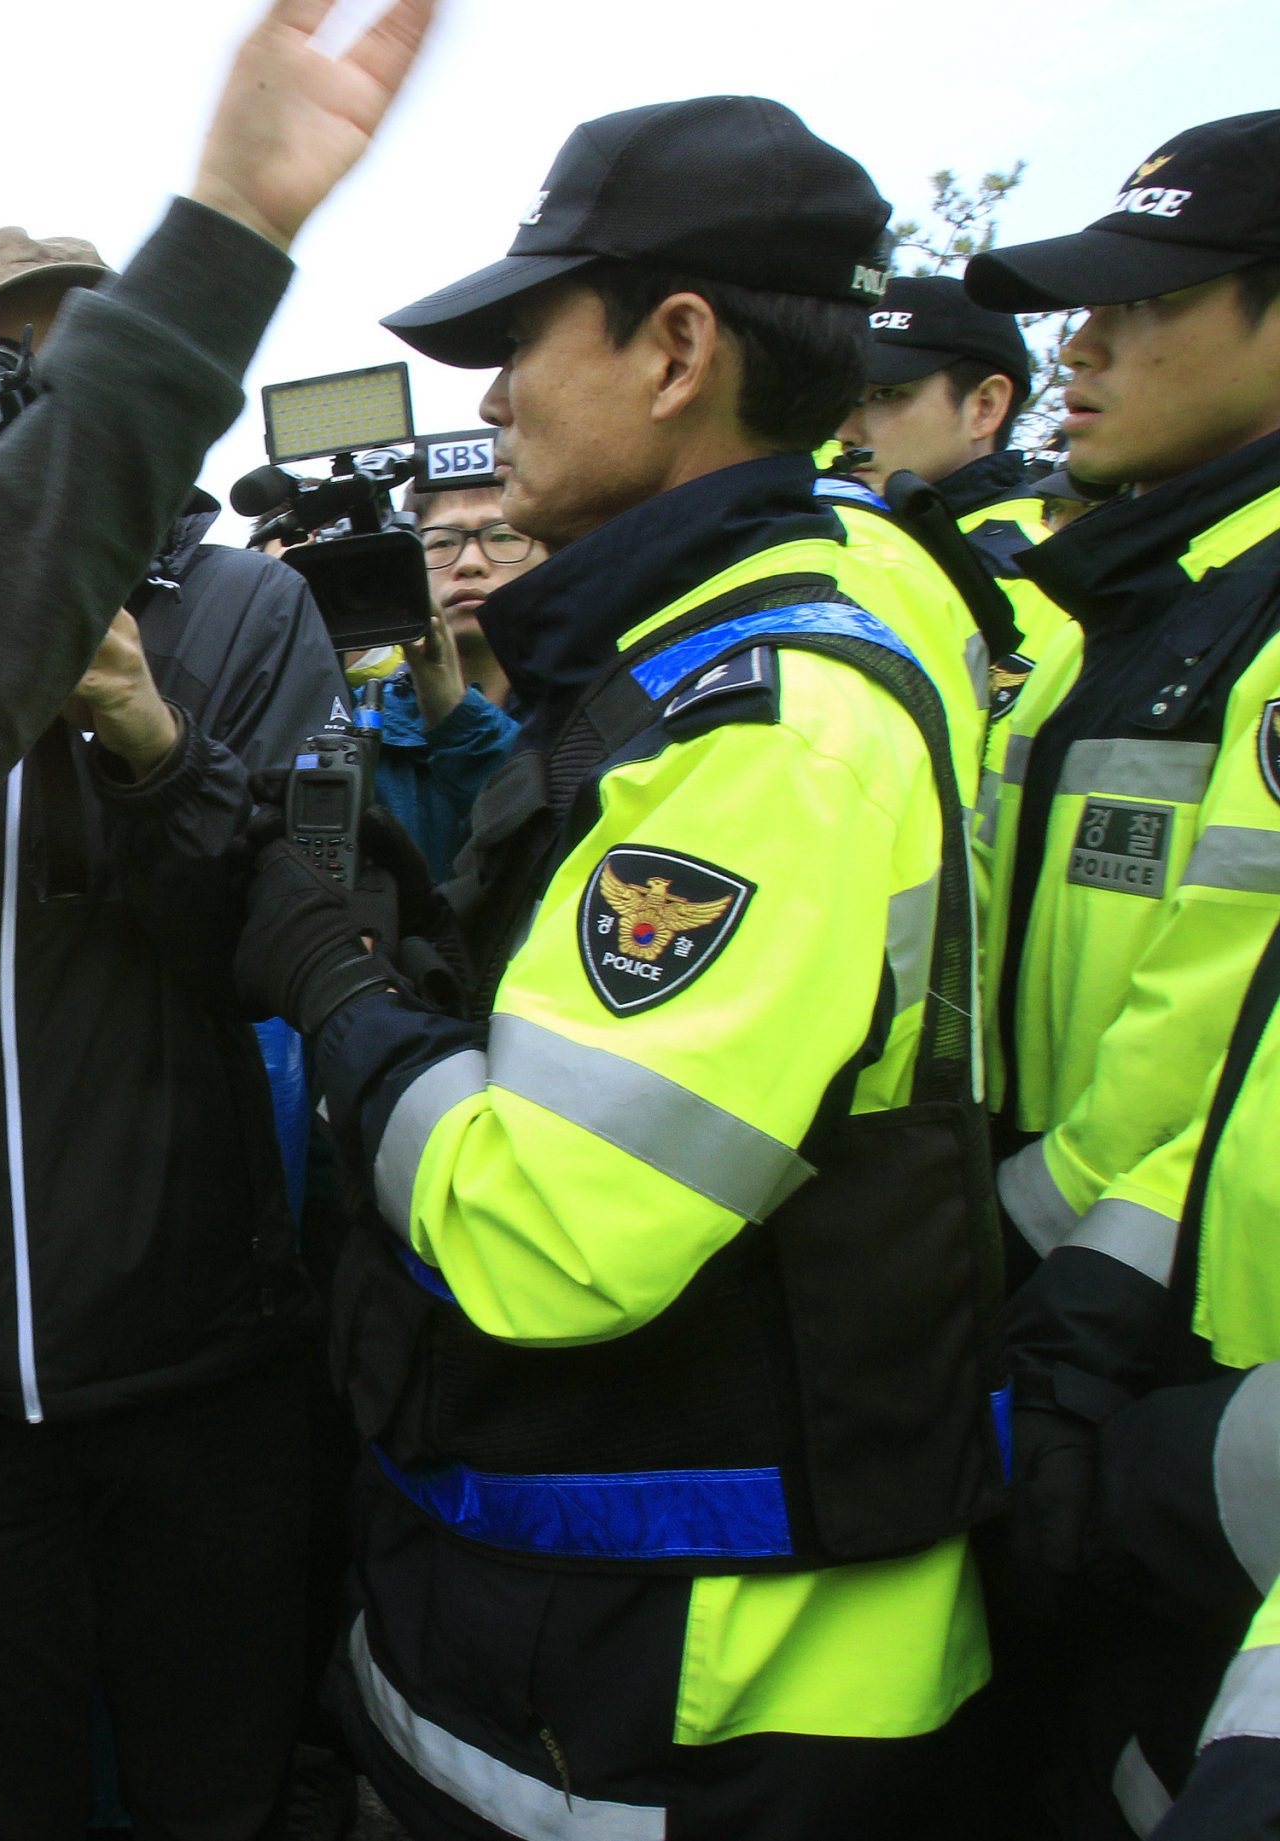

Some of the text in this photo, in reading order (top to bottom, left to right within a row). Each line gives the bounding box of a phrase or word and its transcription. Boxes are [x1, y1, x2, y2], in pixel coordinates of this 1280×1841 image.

[1118, 186, 1193, 218] ICE
[433, 443, 489, 474] SBS
[1071, 855, 1156, 886] POLICE
[597, 913, 695, 958] 경 찰
[601, 951, 664, 982] POLICE
